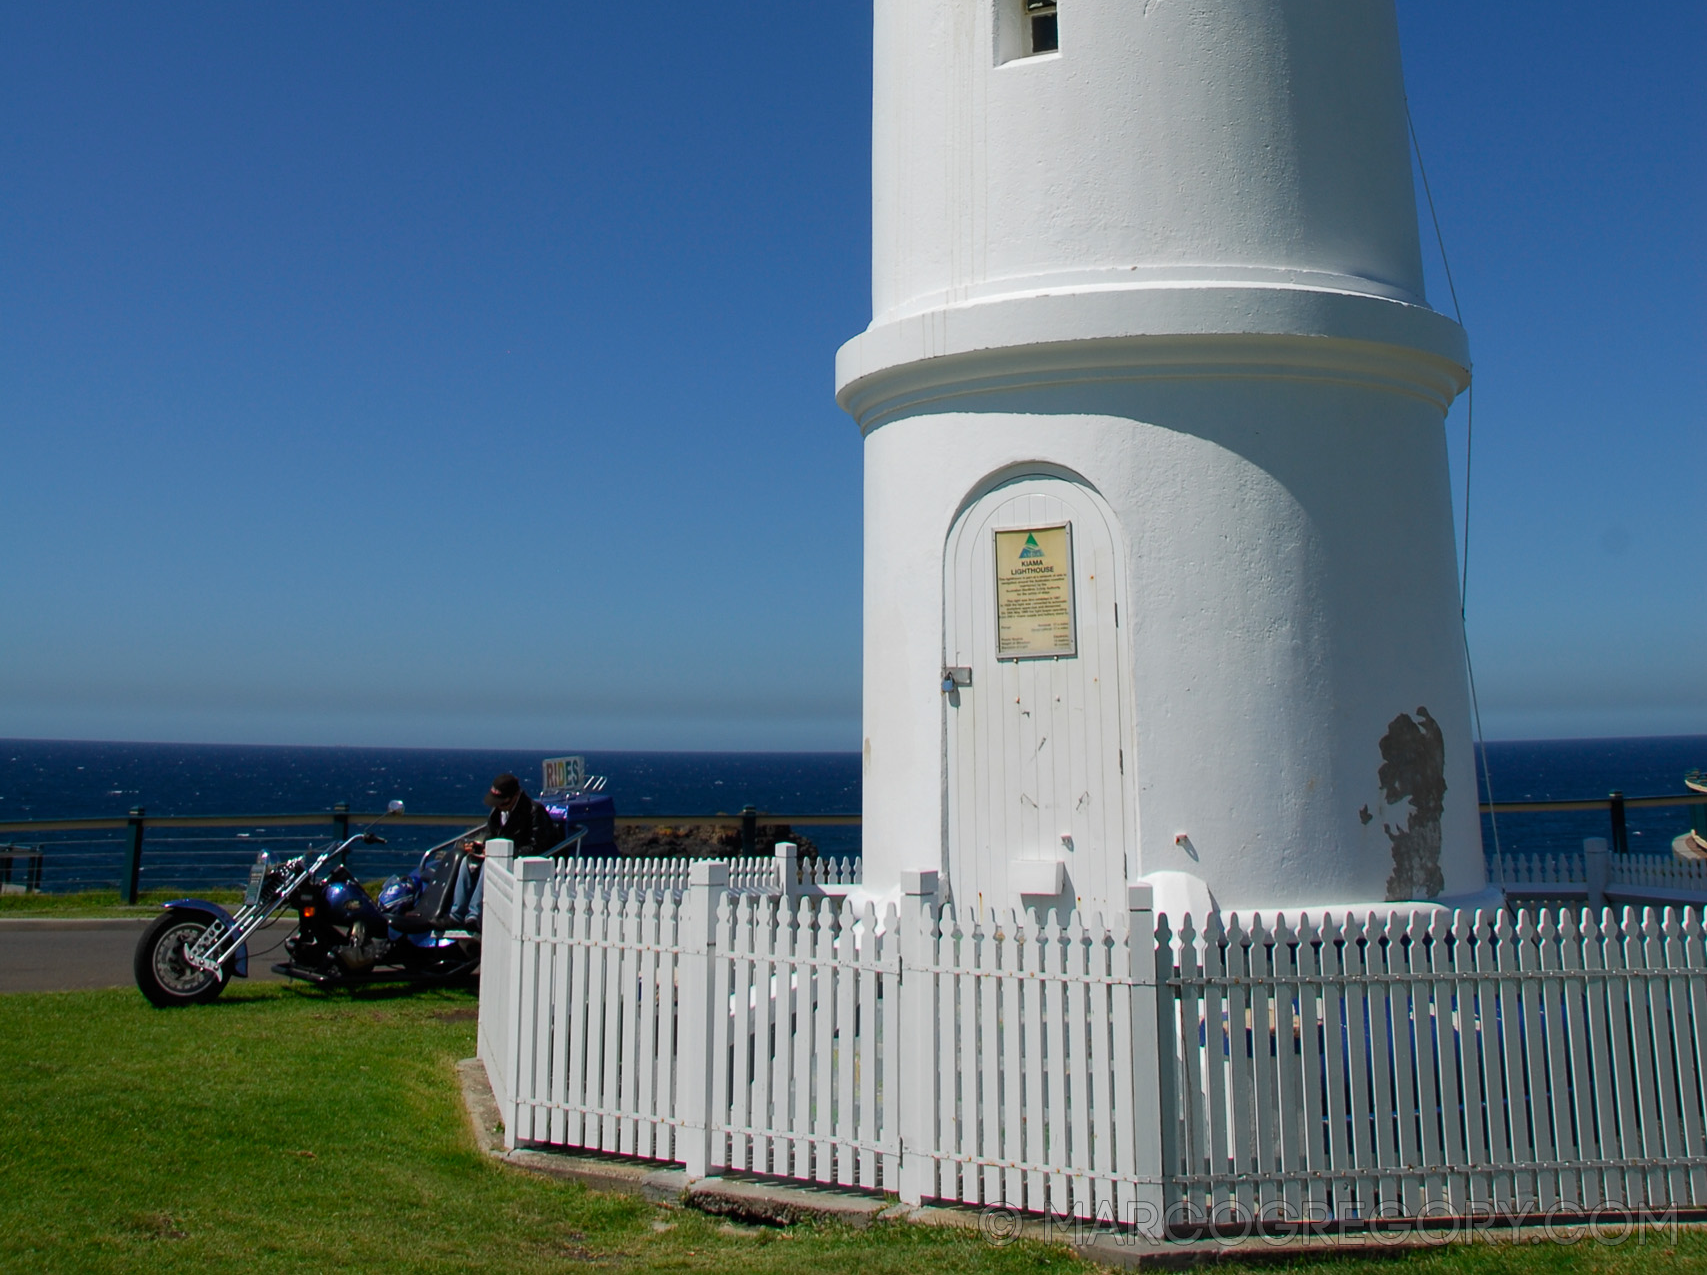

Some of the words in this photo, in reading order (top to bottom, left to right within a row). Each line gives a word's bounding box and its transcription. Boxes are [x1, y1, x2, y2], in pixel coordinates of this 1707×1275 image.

[1021, 559, 1043, 567] KIAMA
[1011, 566, 1054, 575] LIGHTHOUSE
[546, 760, 579, 787] RIDES
